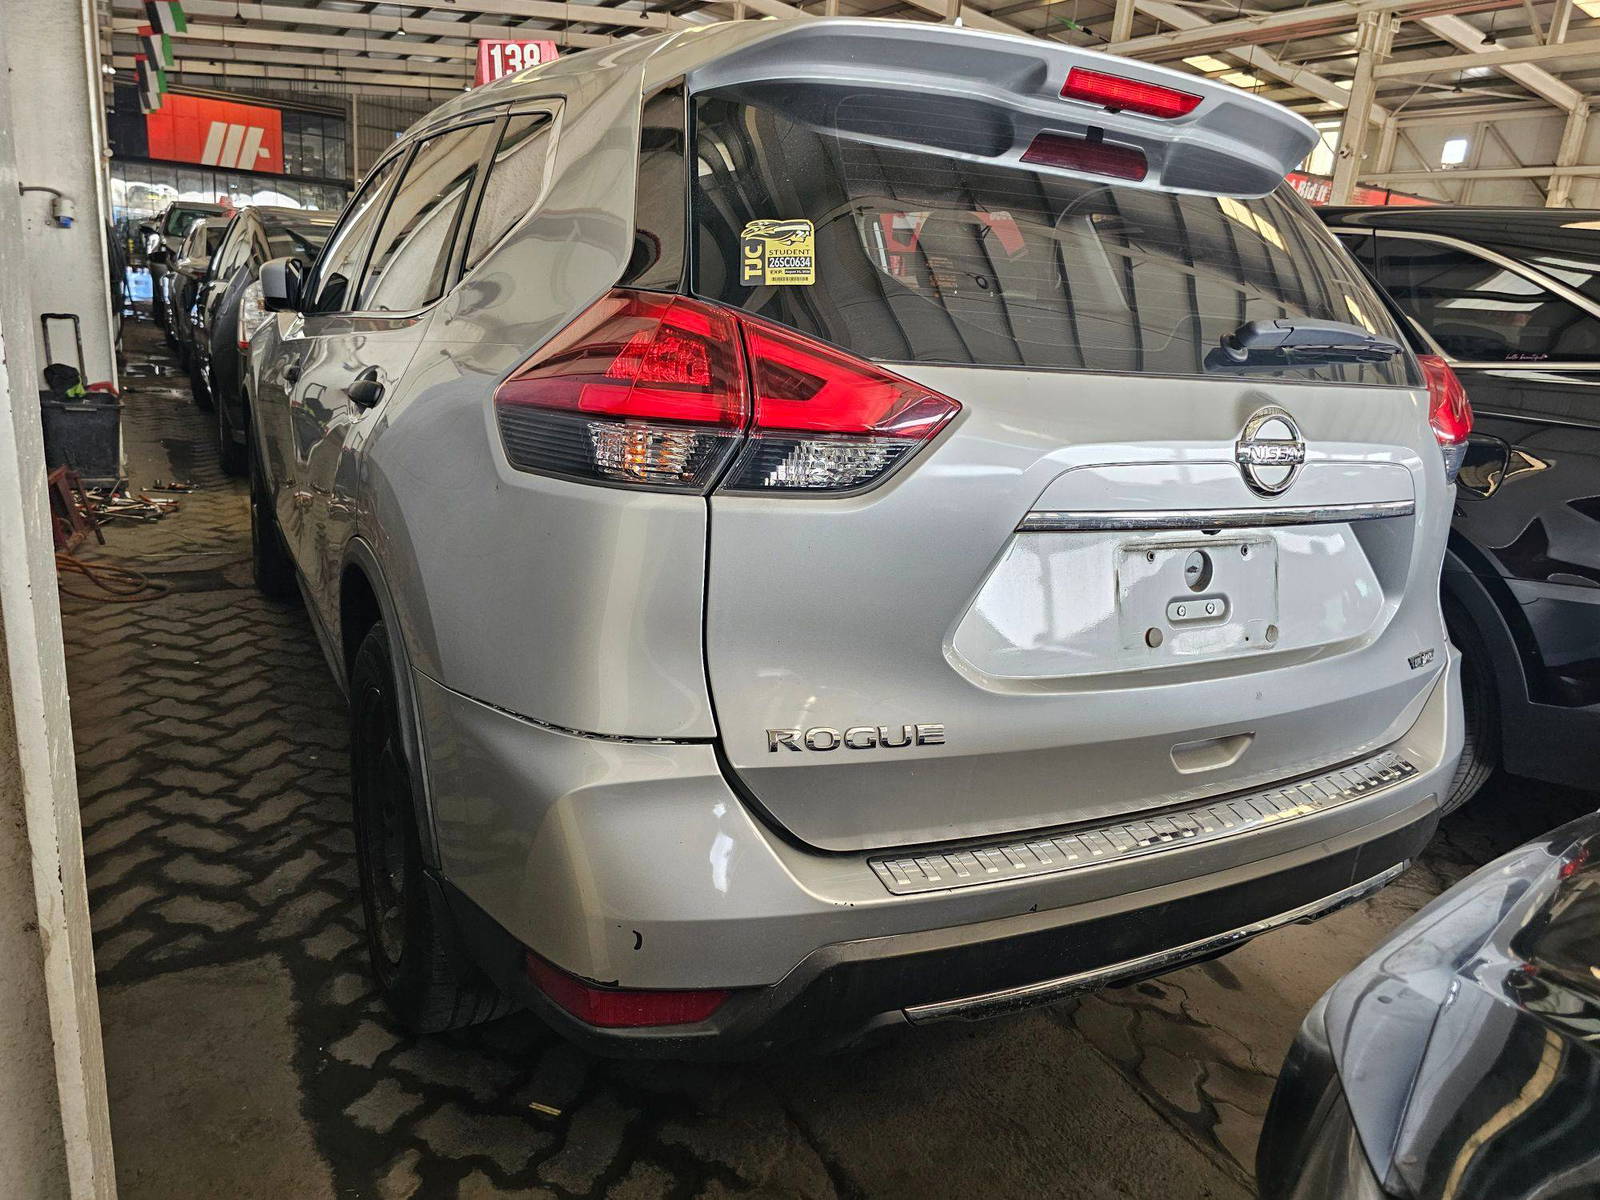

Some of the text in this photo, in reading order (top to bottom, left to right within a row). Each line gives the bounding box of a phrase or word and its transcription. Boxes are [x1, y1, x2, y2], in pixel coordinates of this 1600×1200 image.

[490, 43, 541, 80] 138
[744, 243, 763, 281] TJC
[768, 257, 811, 268] 26SC0634
[766, 723, 946, 753] ROGUE
